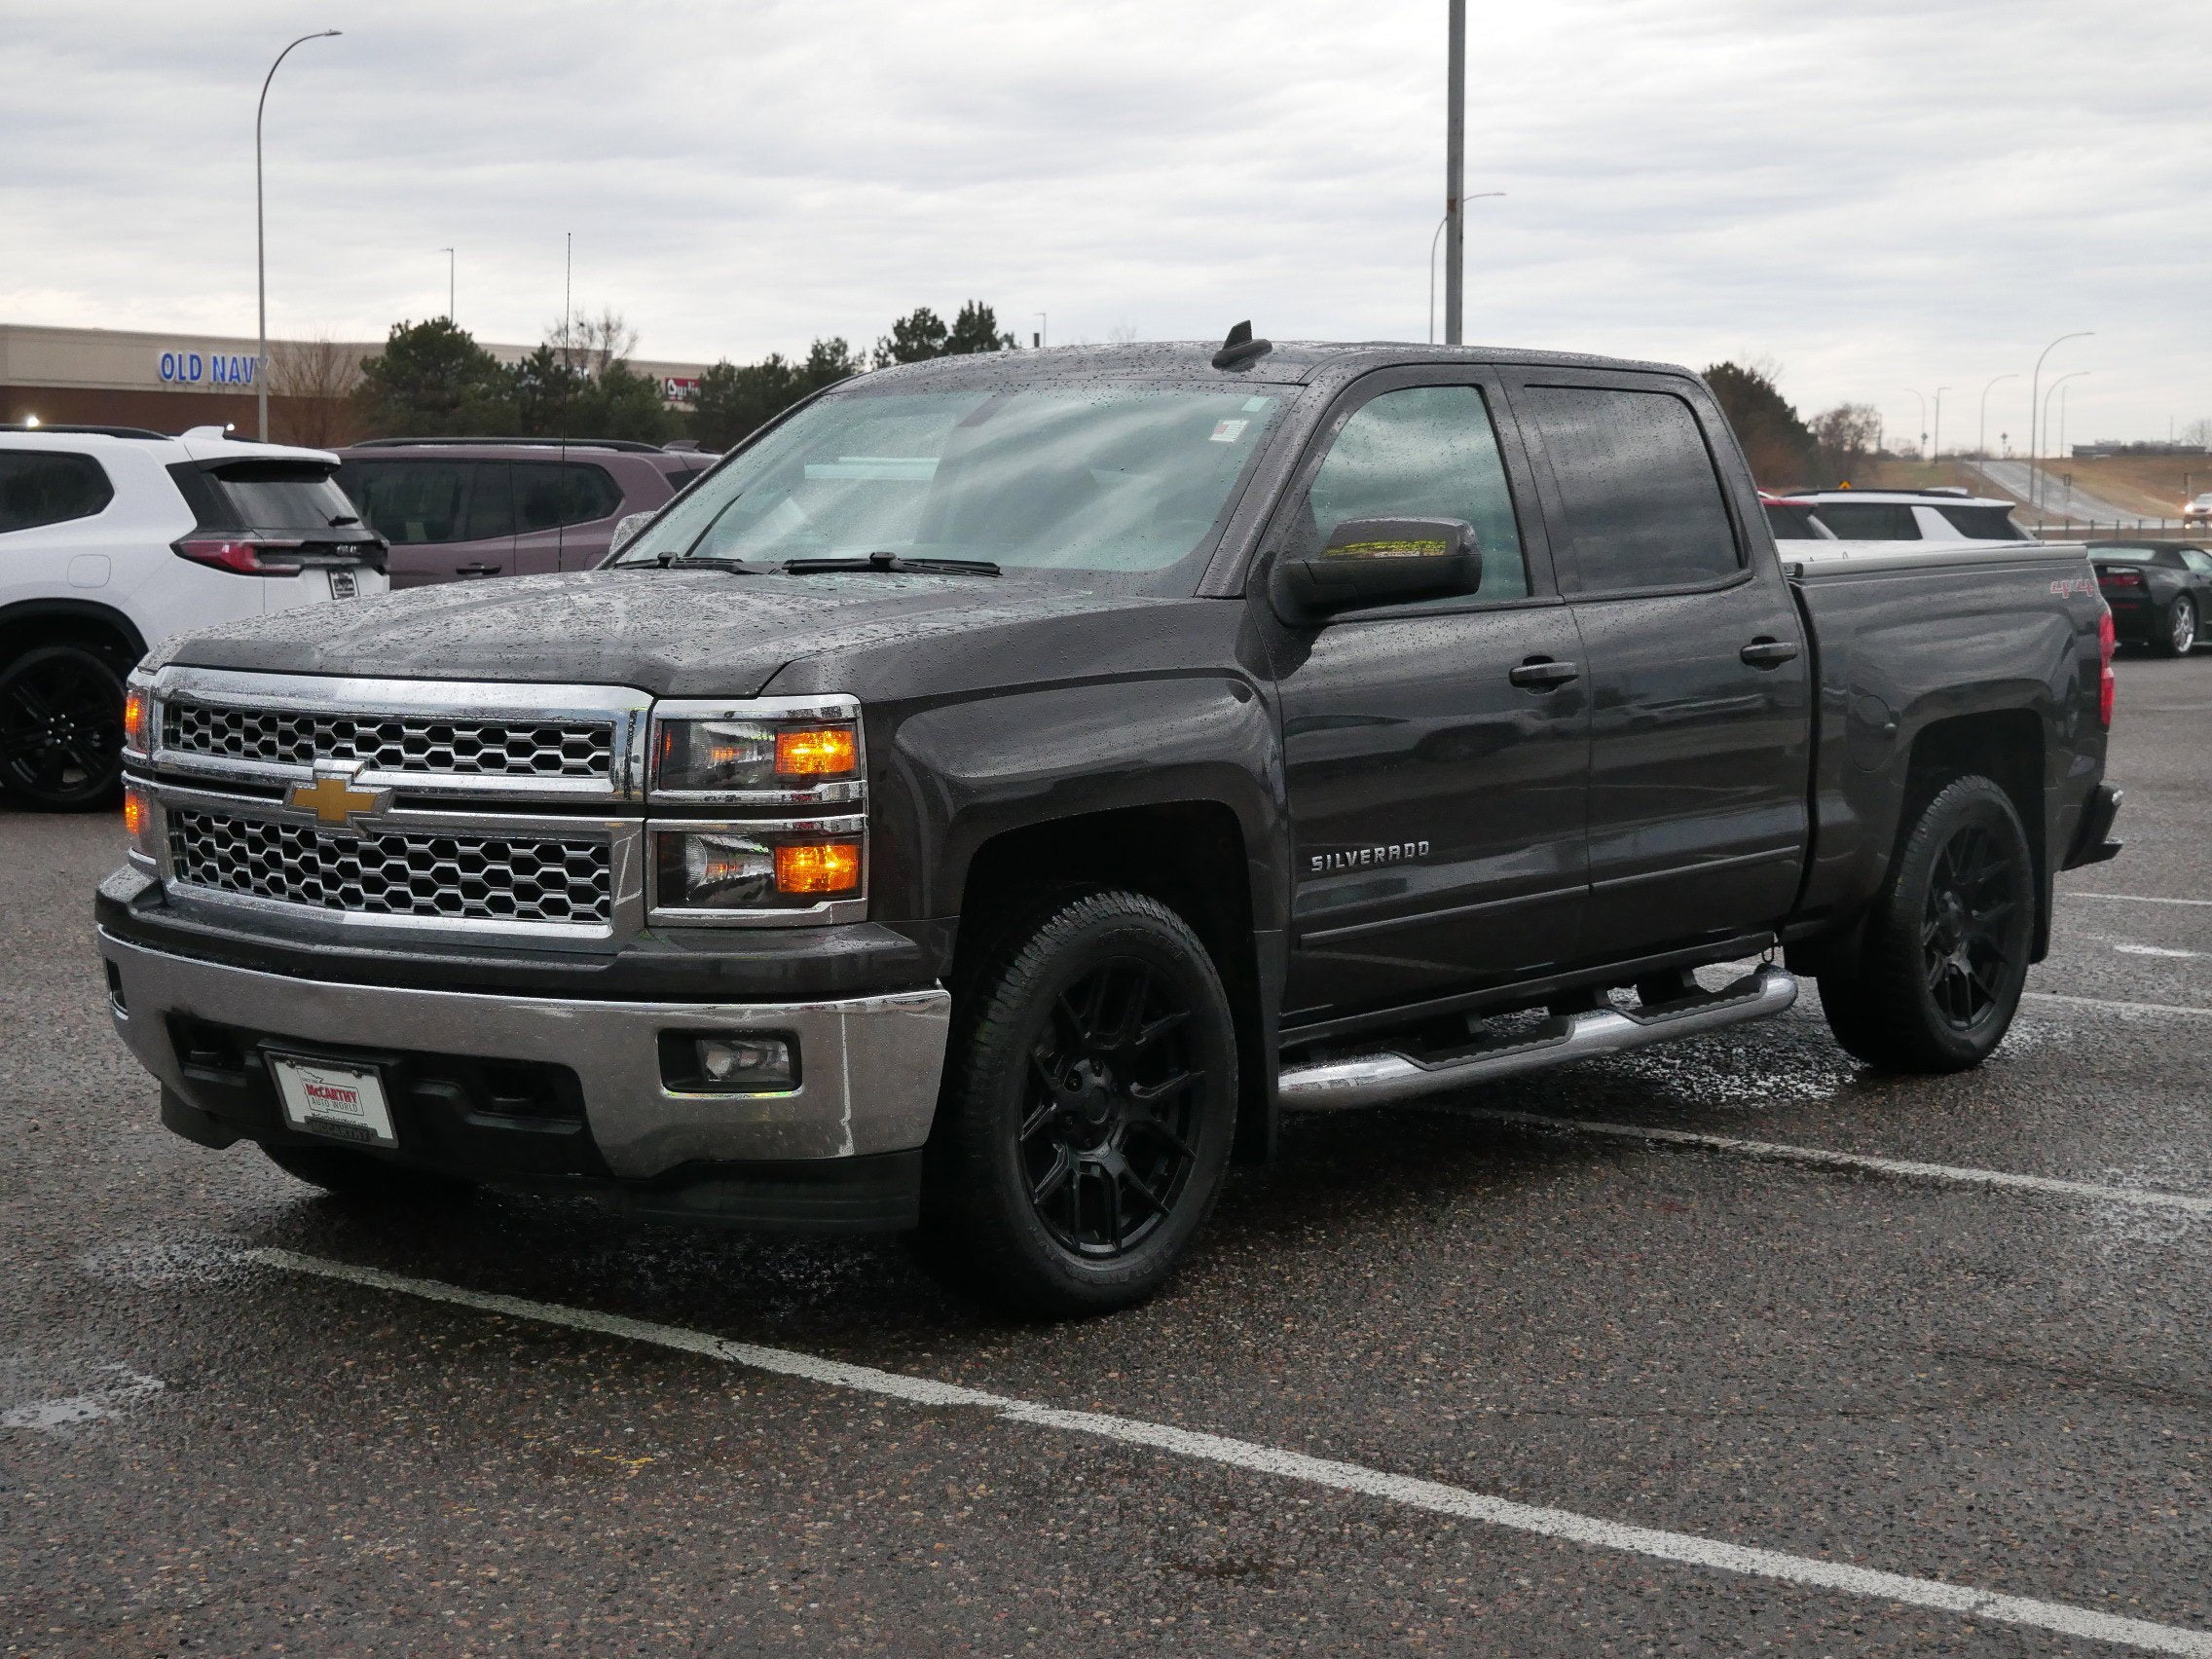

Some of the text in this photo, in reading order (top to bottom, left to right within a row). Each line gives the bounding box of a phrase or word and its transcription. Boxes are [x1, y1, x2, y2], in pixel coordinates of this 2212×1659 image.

[160, 351, 203, 382] OLD
[1310, 840, 1430, 871] SILVERADO
[312, 1096, 358, 1112] AUTO WORLD
